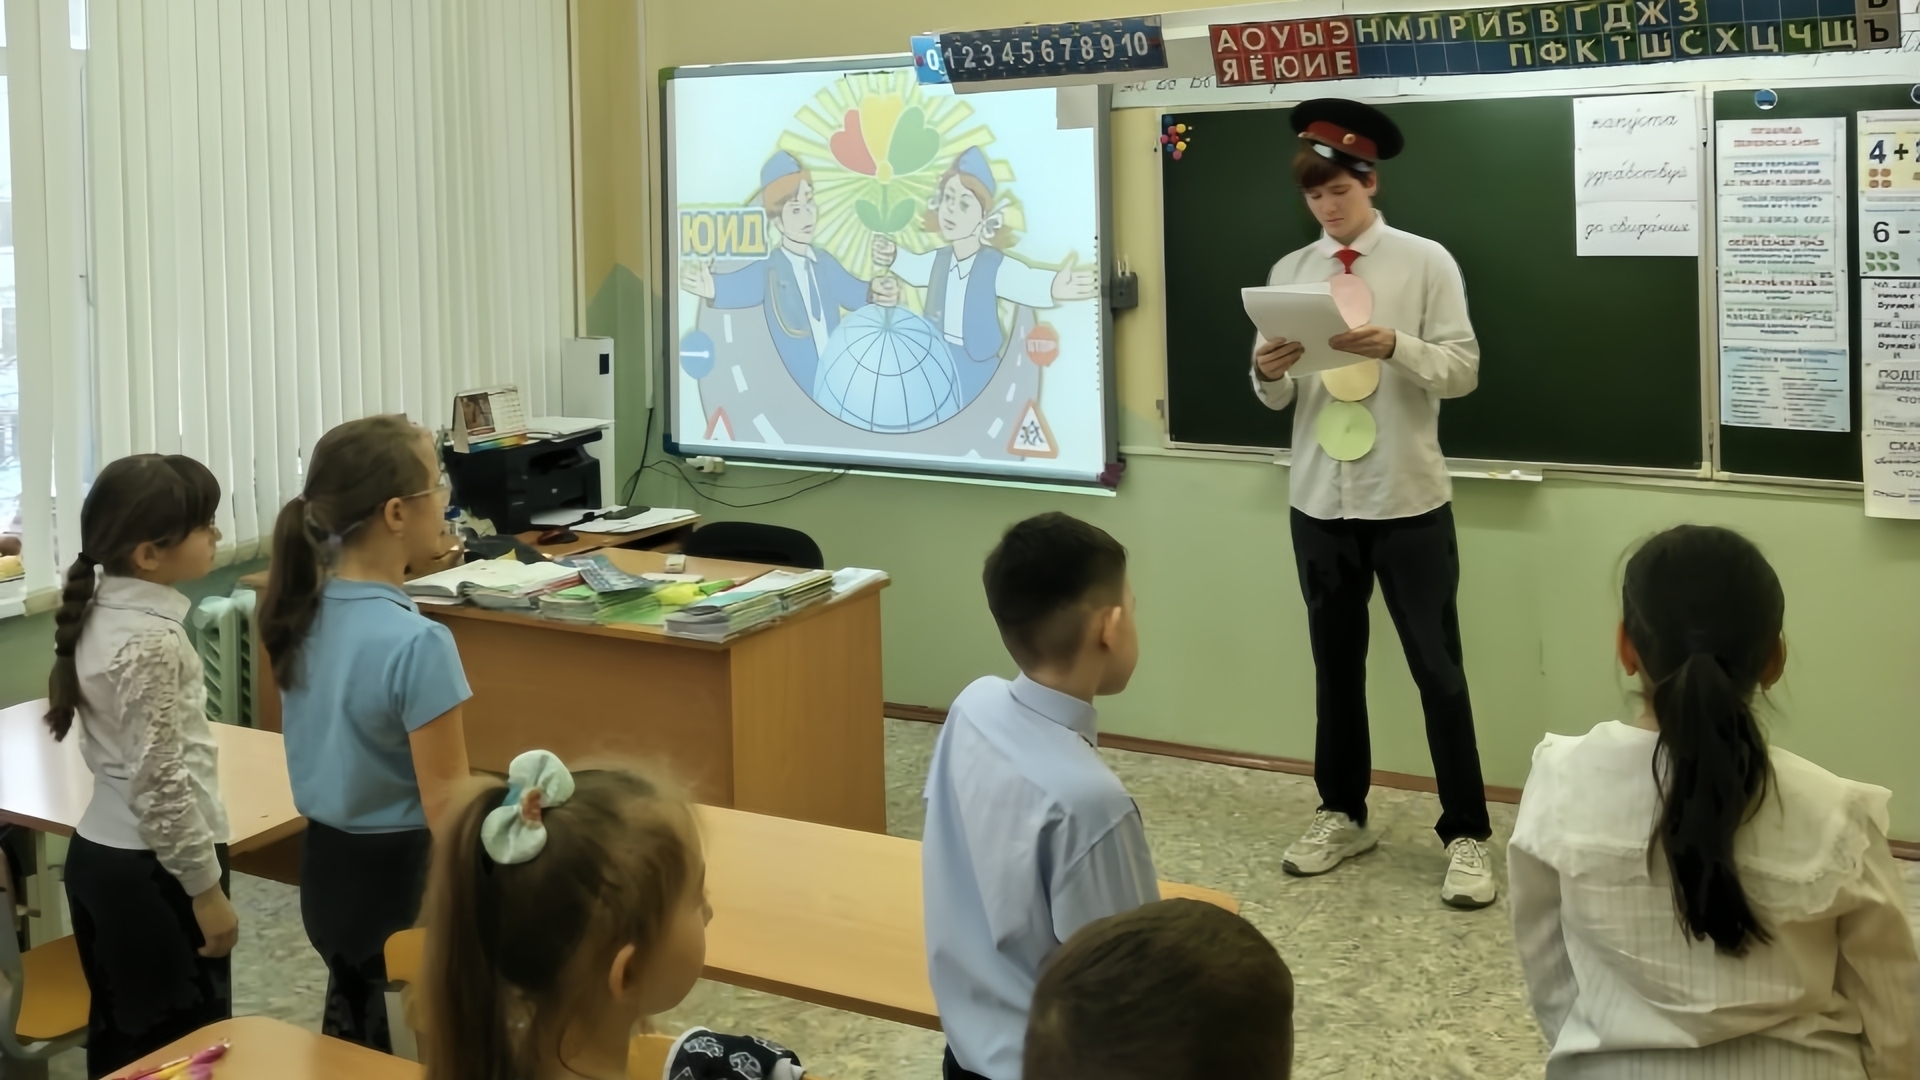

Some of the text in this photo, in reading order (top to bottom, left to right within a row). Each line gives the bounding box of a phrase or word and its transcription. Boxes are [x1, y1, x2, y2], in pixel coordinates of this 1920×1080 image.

[1869, 140, 1887, 164] 4
[681, 211, 768, 256] ЮИД
[1873, 221, 1890, 242] 6
